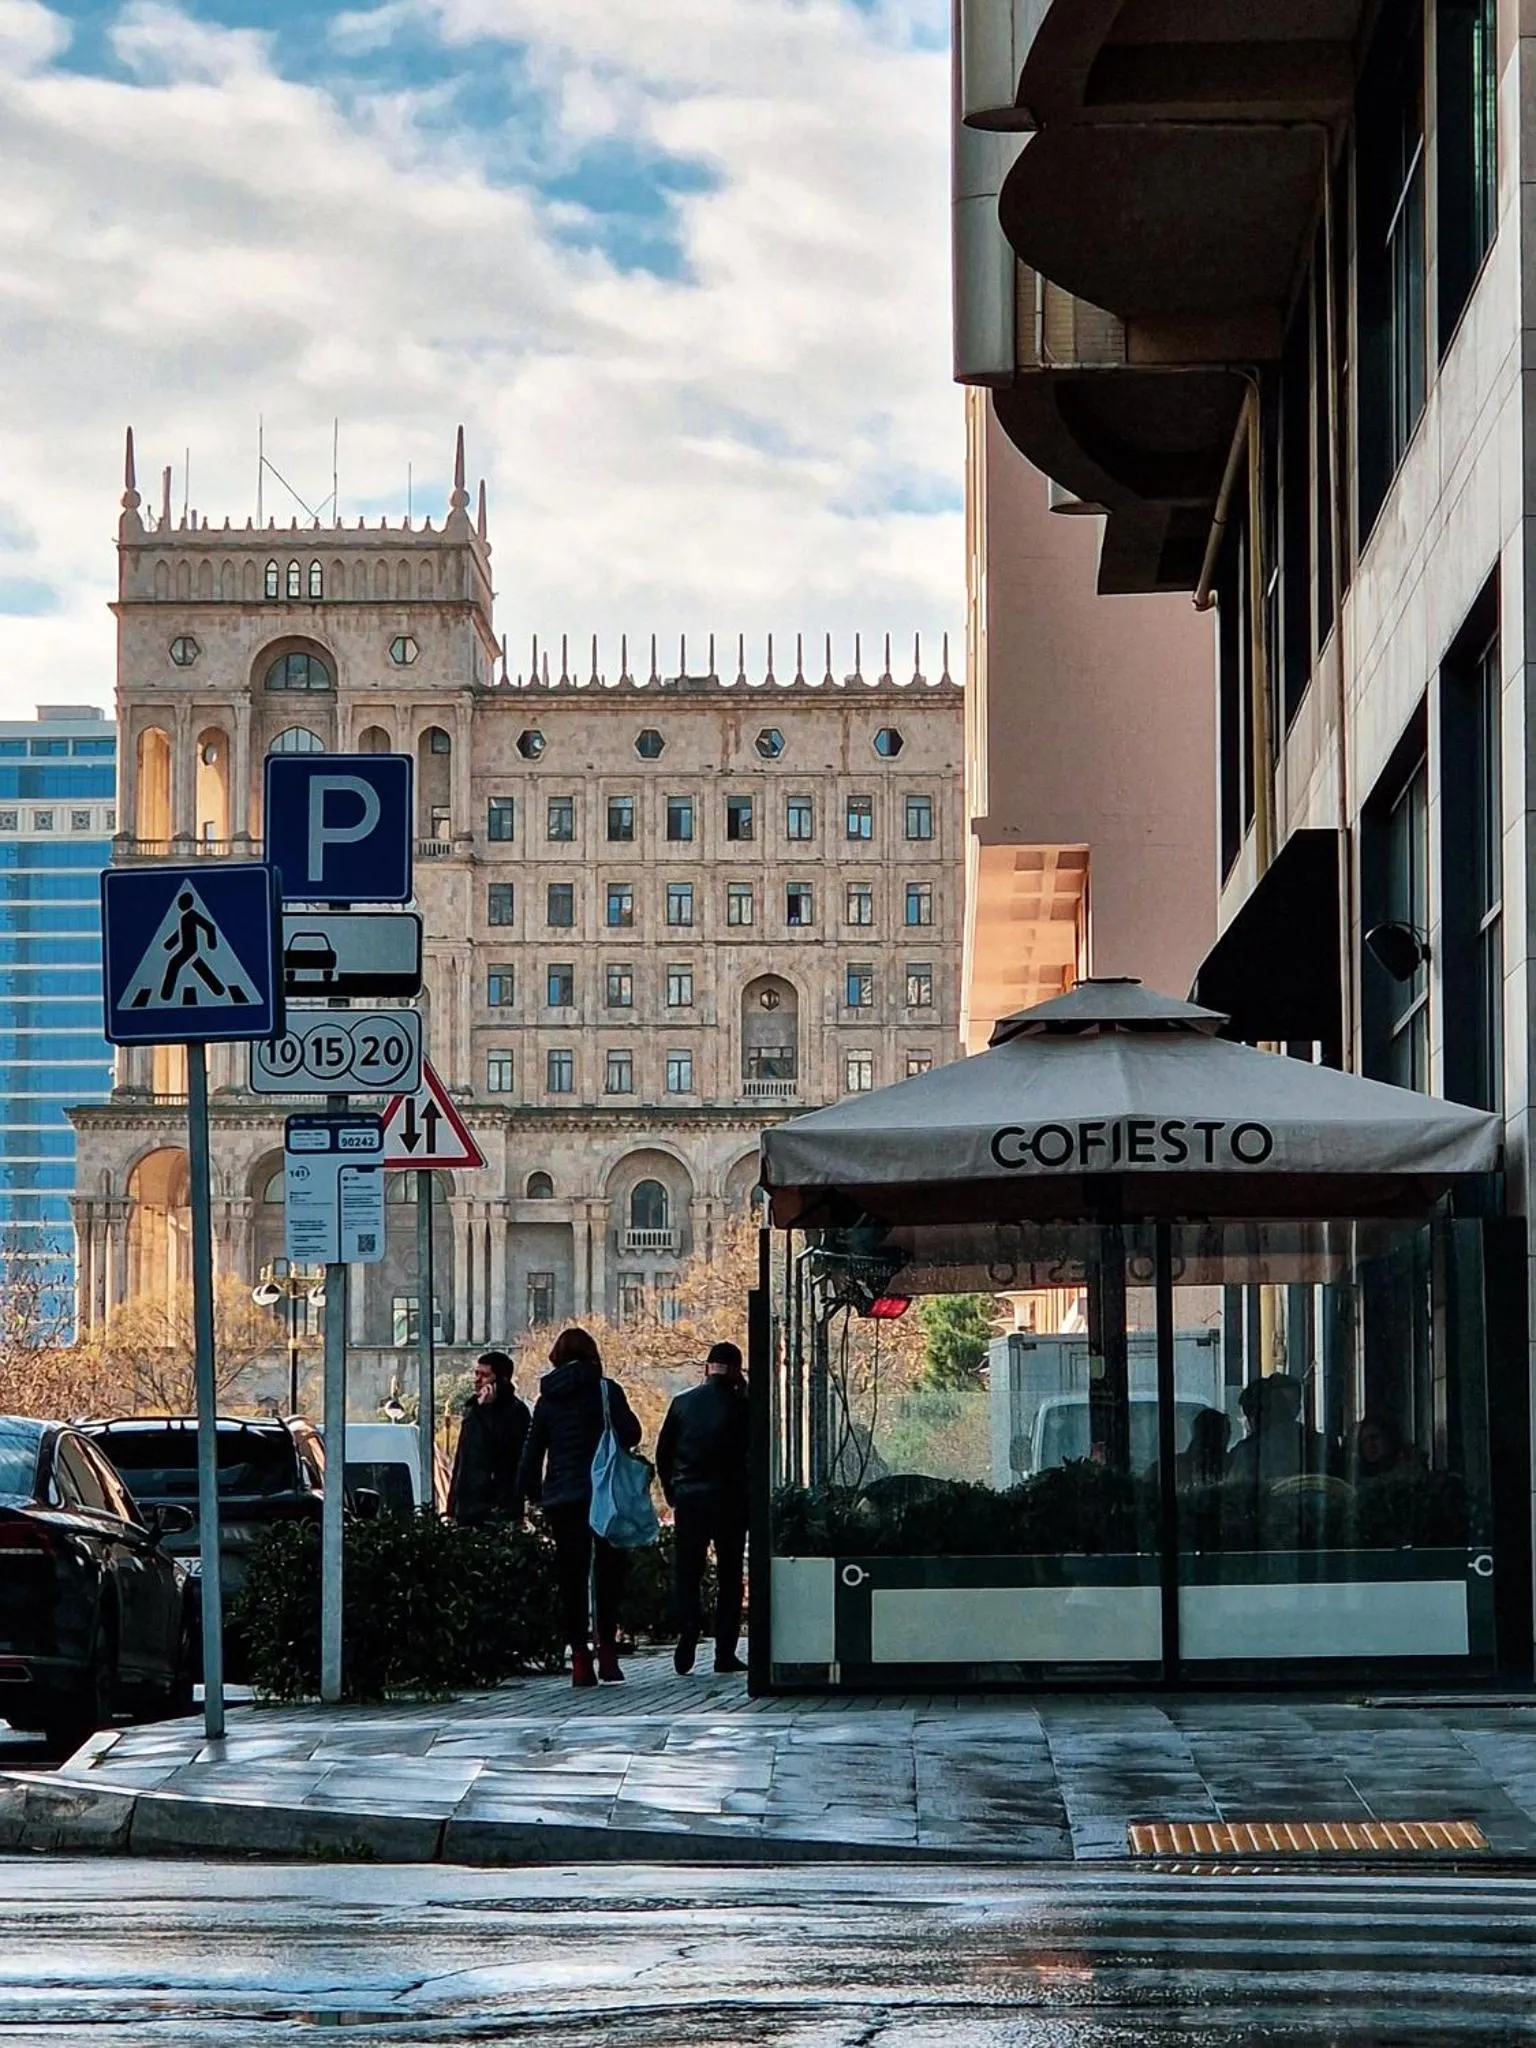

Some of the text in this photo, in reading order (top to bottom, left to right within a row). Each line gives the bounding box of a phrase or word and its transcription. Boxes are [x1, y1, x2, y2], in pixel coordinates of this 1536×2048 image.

[308, 775, 381, 882] P
[267, 1036, 404, 1067] 10 15 20
[341, 1137, 375, 1148] 90242
[991, 1120, 1274, 1169] COFIESTO
